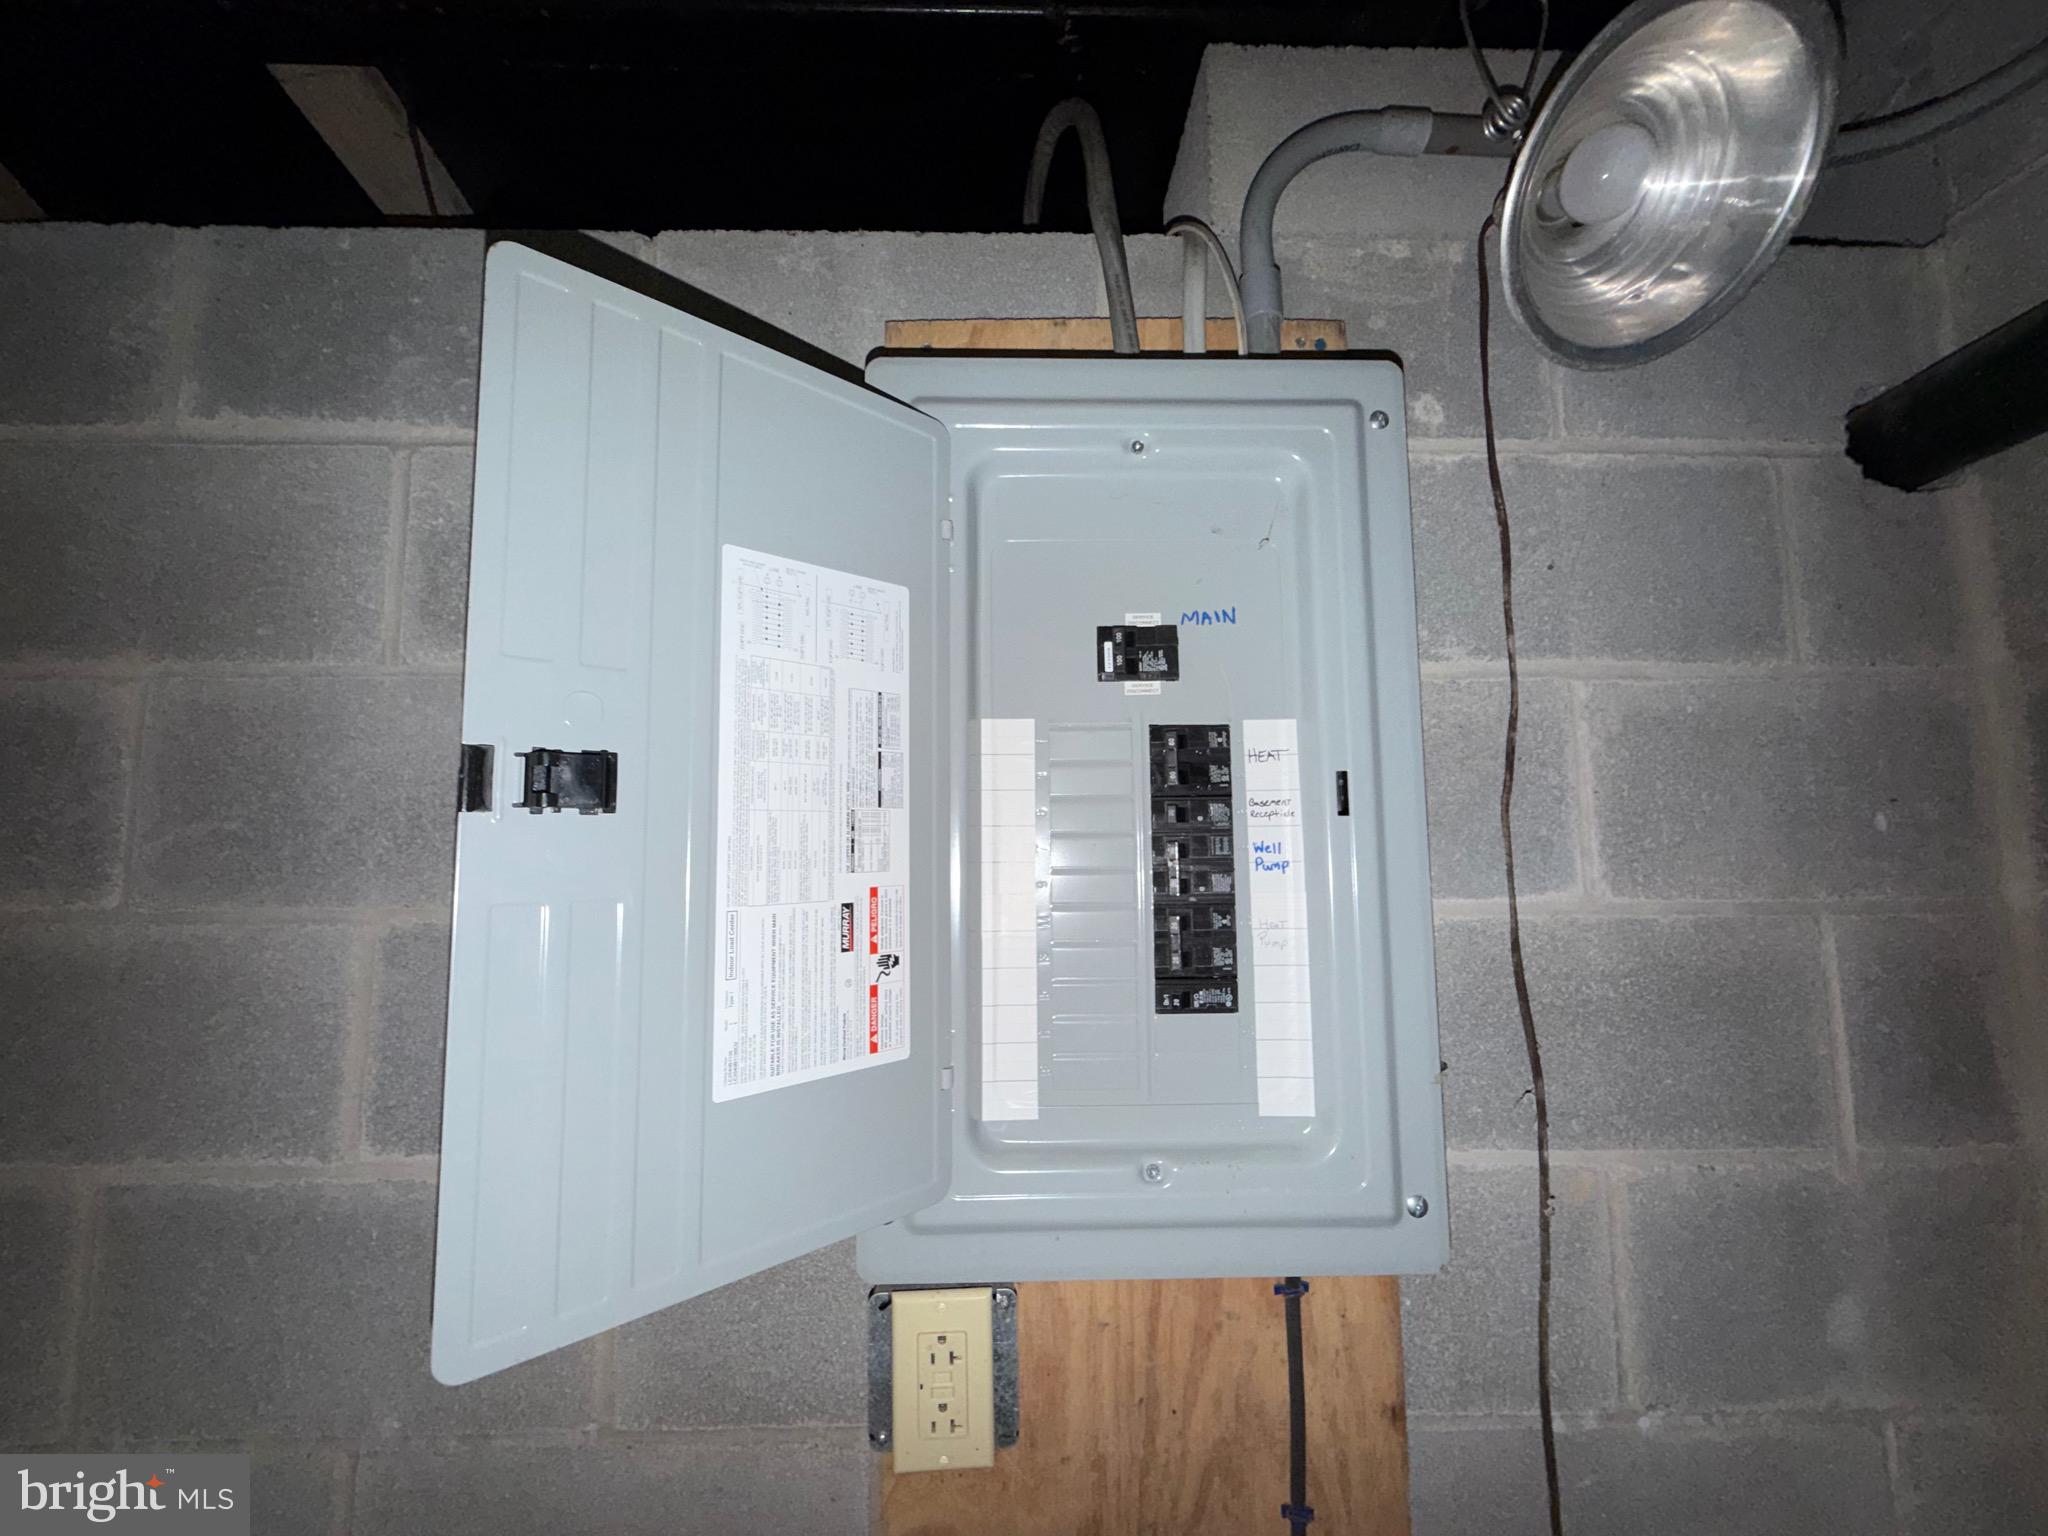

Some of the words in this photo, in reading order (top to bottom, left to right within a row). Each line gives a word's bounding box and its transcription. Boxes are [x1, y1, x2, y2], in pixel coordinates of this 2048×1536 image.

[1181, 606, 1236, 625] MAIN
[1248, 749, 1289, 763] HEAT
[1253, 842, 1281, 855] Well
[1255, 856, 1290, 874] Pump
[870, 896, 878, 932] PELIGRO
[842, 906, 850, 950] MURRAY
[870, 996, 878, 1032] DANGER
